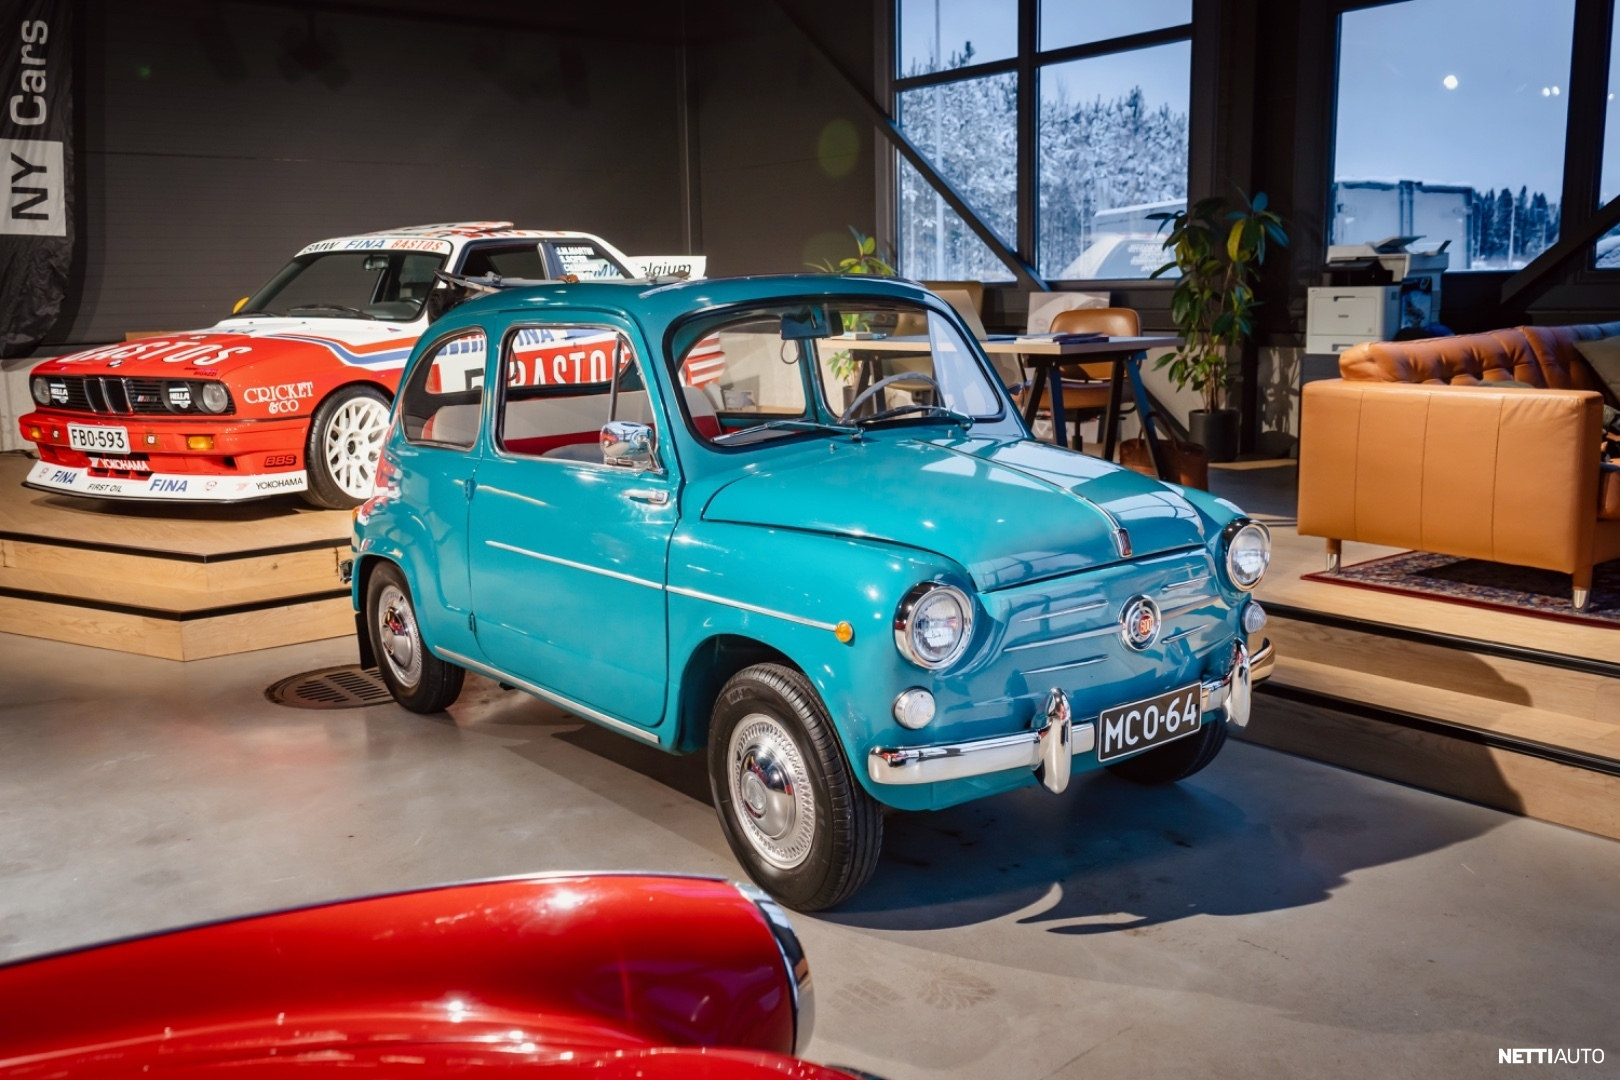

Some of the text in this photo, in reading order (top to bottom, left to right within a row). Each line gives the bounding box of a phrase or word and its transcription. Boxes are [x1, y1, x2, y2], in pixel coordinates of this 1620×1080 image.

[10, 20, 49, 220] NY Cars
[344, 240, 386, 249] FINA
[390, 240, 443, 251] BASTOS
[169, 391, 190, 400] HELLA
[243, 381, 314, 404] CRICKET
[268, 399, 299, 415] &CO
[265, 455, 296, 467] BBS
[50, 470, 78, 485] FINA
[256, 477, 304, 490] YOKOHAMA
[87, 483, 122, 493] FIRST OIL
[149, 479, 188, 492] FINA
[1104, 692, 1197, 753] MCO-64
